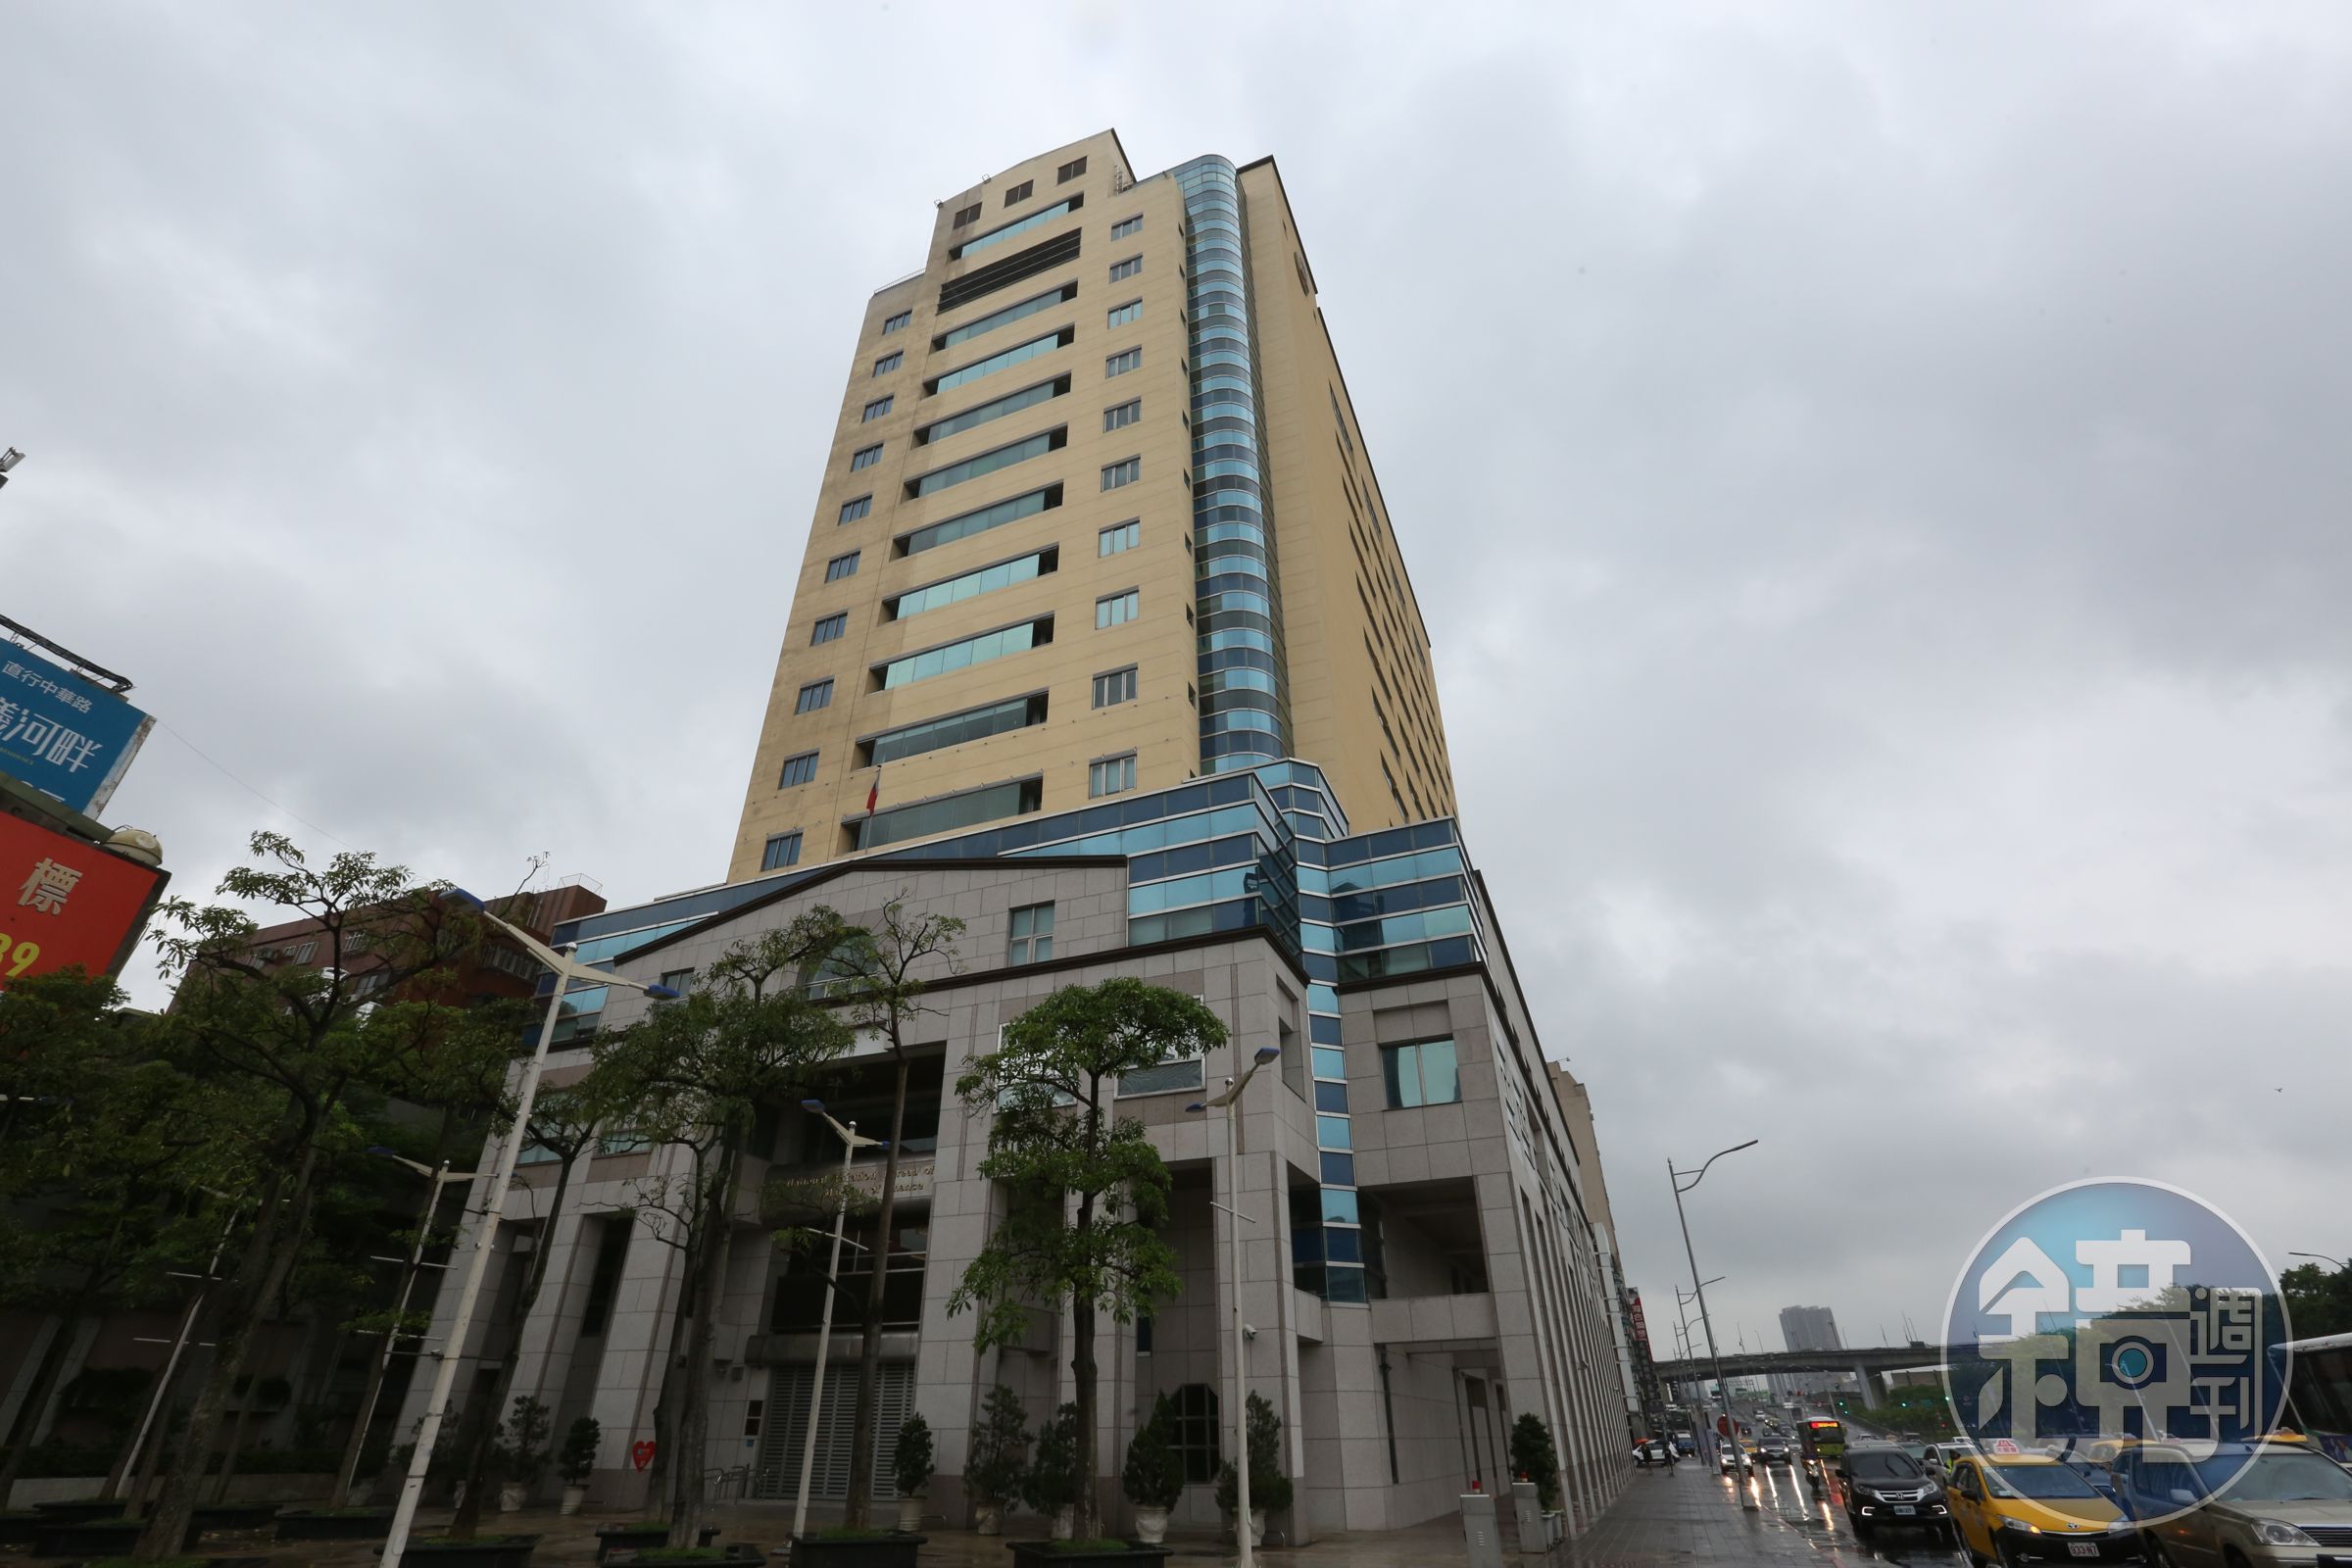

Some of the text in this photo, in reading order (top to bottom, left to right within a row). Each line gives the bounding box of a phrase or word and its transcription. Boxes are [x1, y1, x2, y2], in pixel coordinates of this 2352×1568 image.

[2, 661, 93, 713] 直行中華路
[18, 858, 83, 915] 標
